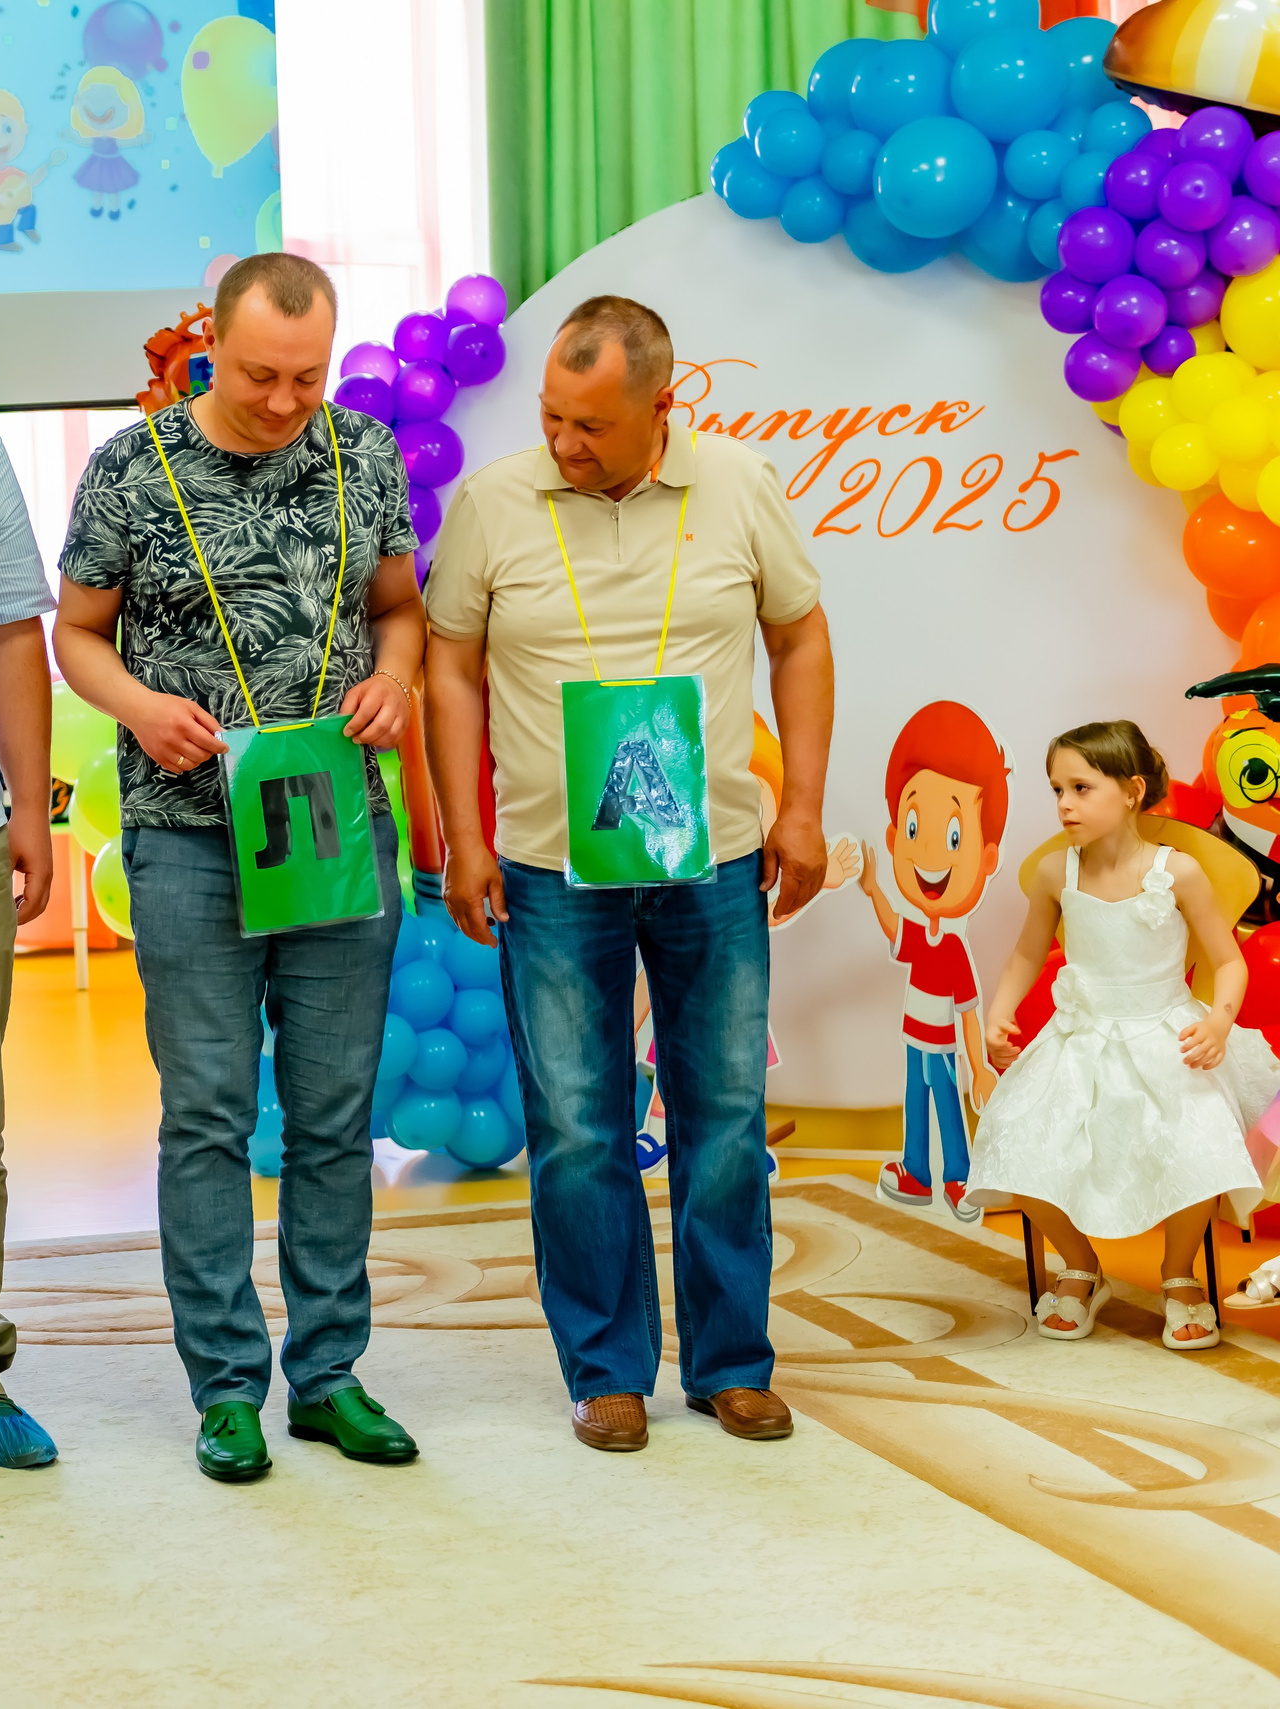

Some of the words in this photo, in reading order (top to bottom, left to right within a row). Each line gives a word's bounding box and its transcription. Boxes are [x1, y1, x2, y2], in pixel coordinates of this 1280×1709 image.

[812, 449, 1080, 538] 2025
[255, 771, 341, 869] Л
[590, 739, 686, 830] А
